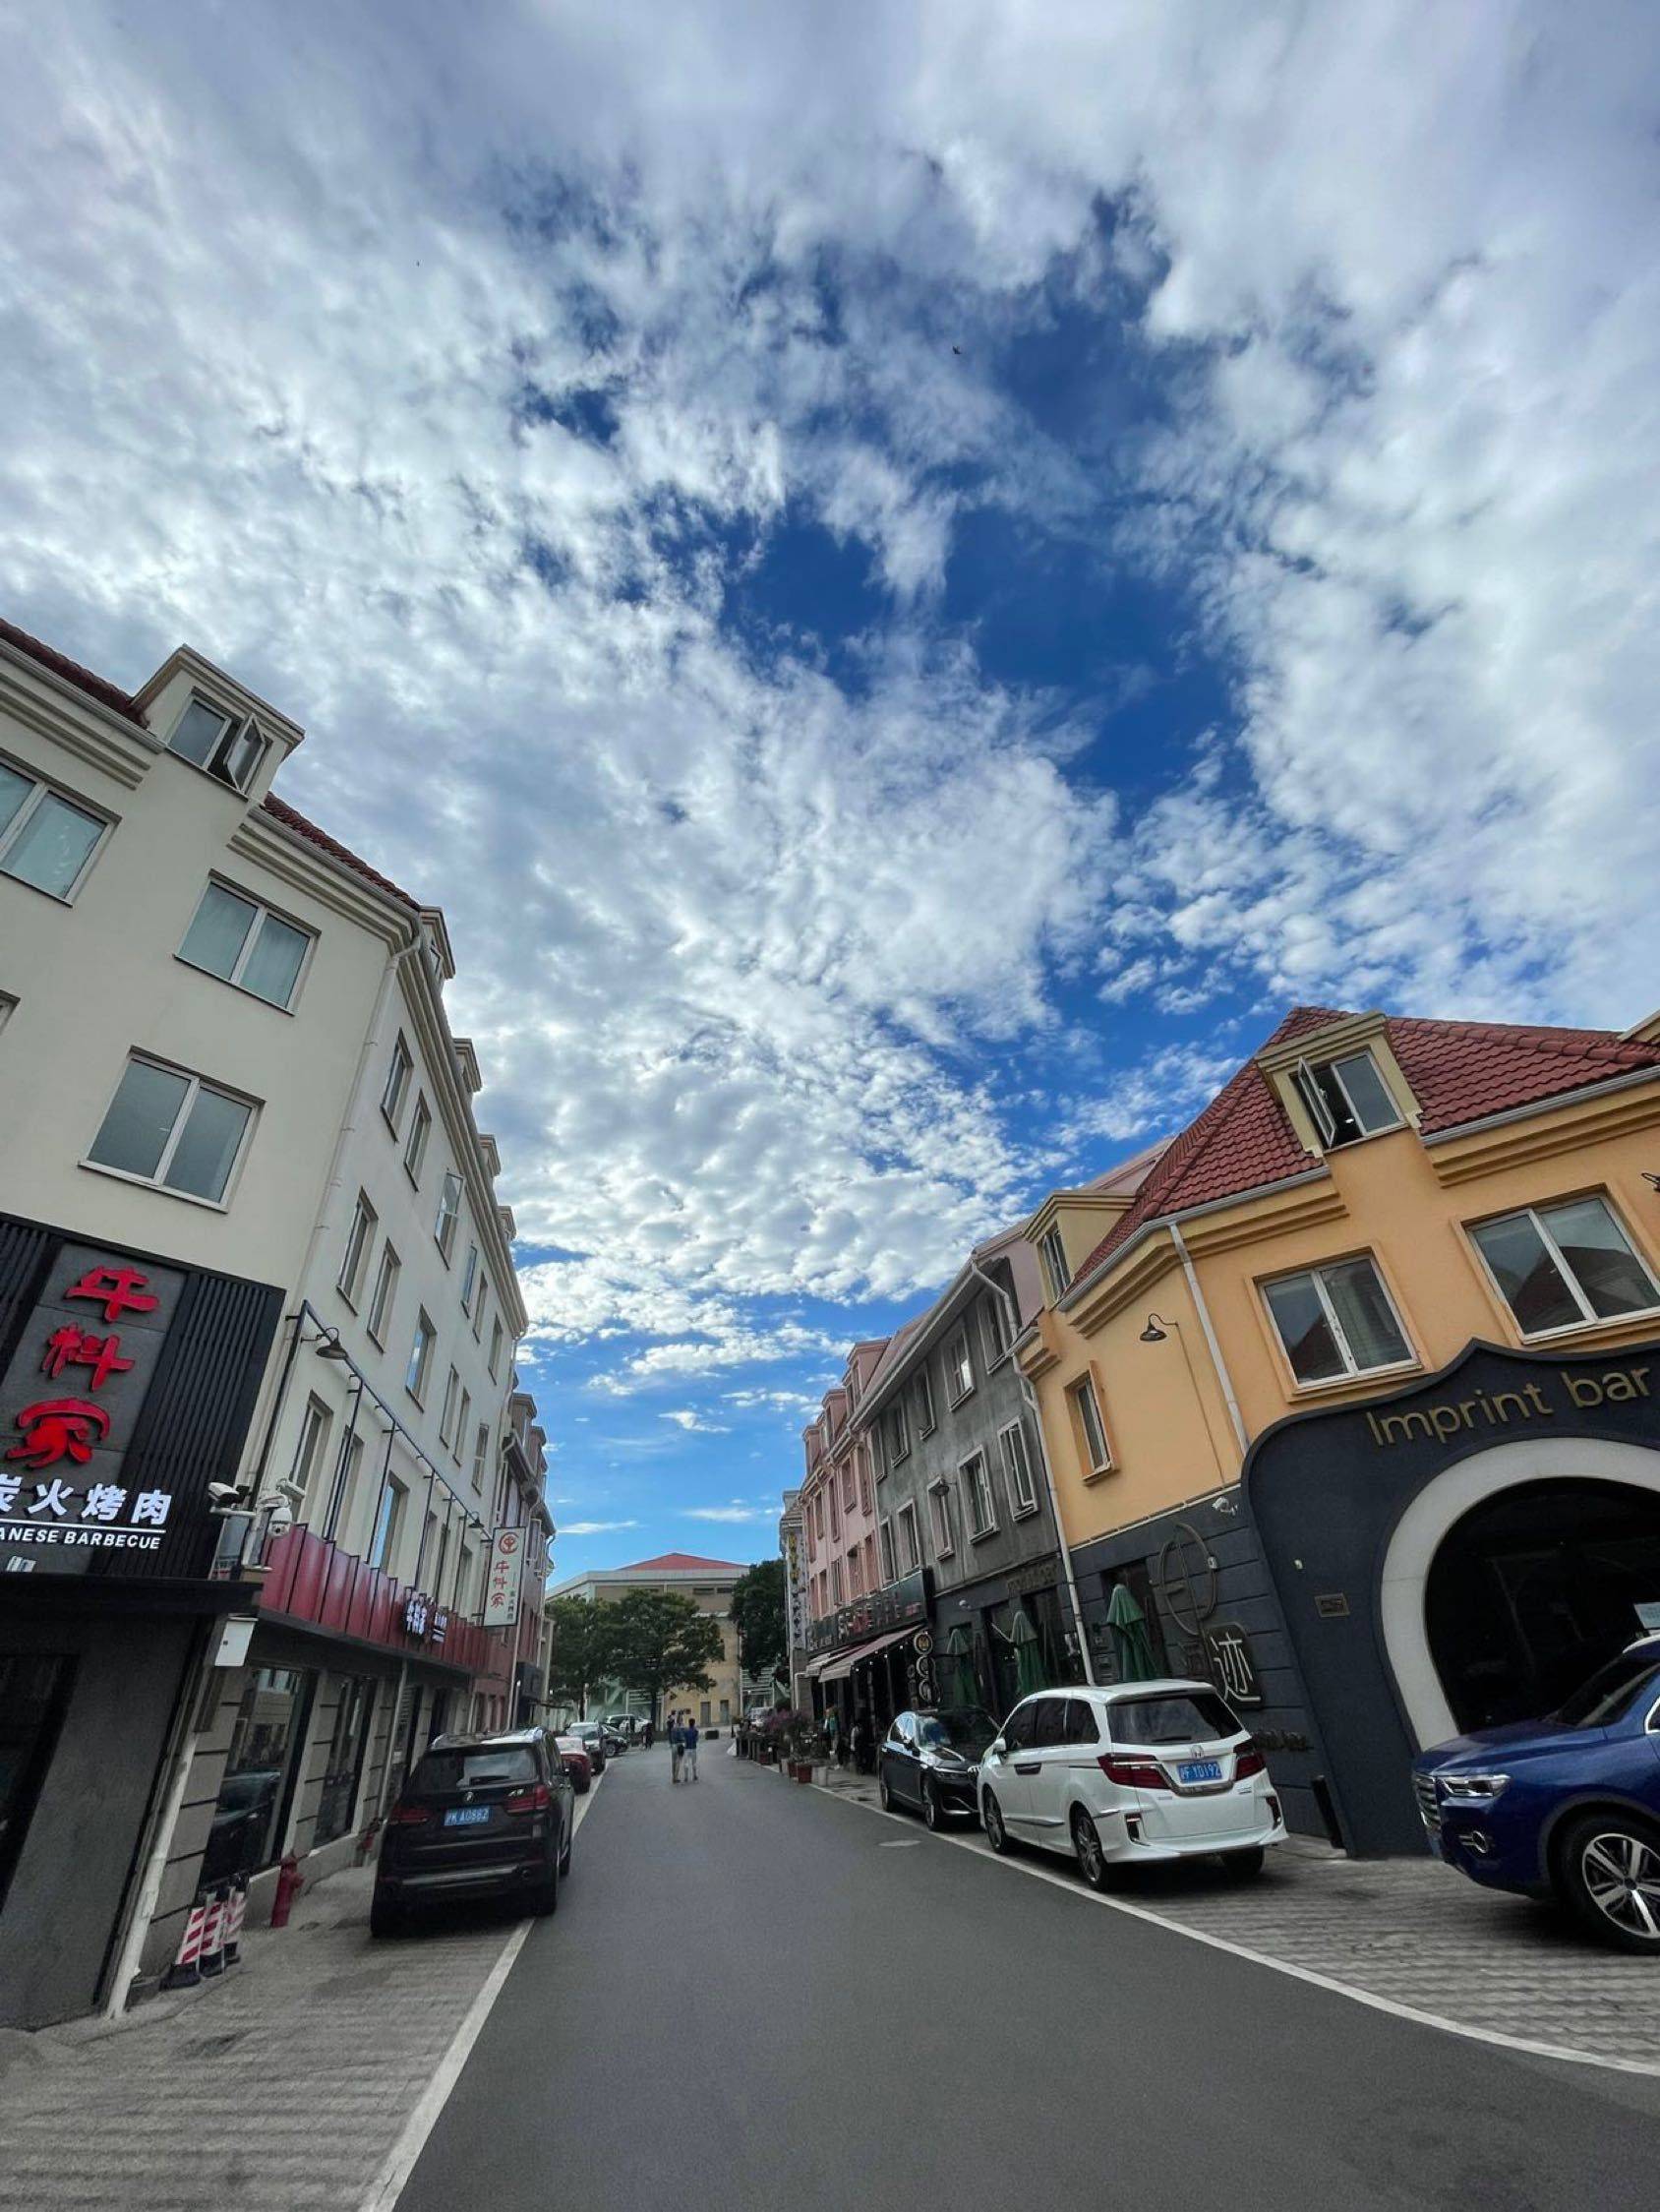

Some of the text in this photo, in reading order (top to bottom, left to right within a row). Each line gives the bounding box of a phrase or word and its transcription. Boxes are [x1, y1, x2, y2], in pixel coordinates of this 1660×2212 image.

[1366, 1367, 1651, 1447] Imprint bar
[64, 1531, 161, 1550] BARBECUE
